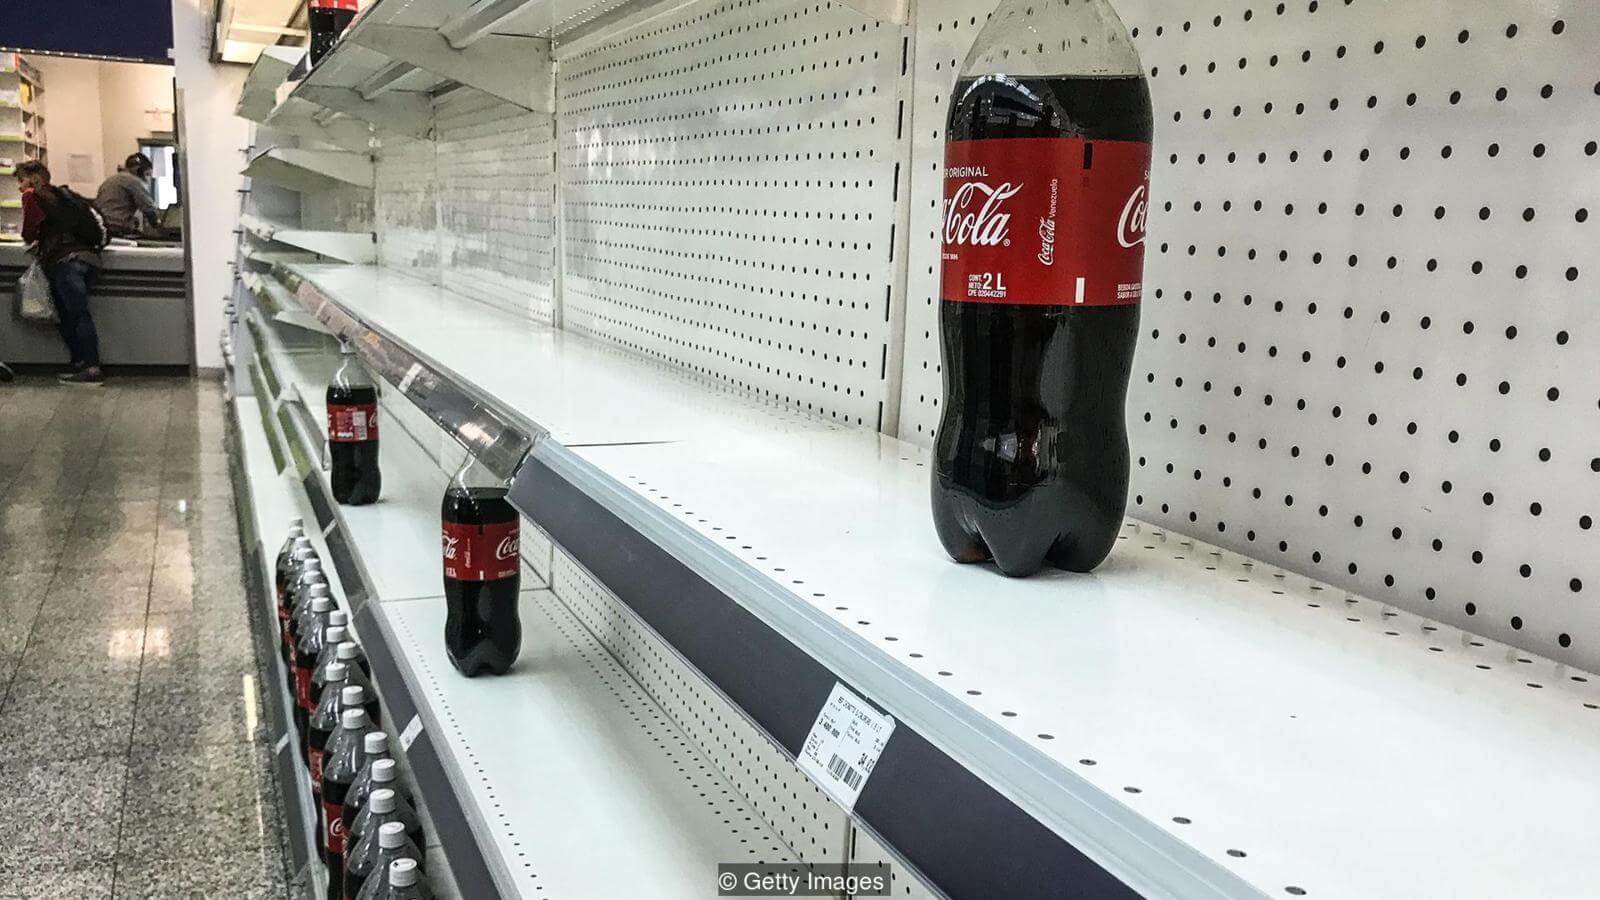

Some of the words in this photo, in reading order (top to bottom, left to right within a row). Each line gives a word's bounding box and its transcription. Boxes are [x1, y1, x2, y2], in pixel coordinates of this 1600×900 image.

[949, 166, 989, 178] ORIGINAL
[1049, 178, 1058, 219] Venezuela
[982, 272, 993, 290] 2
[996, 272, 1007, 290] L
